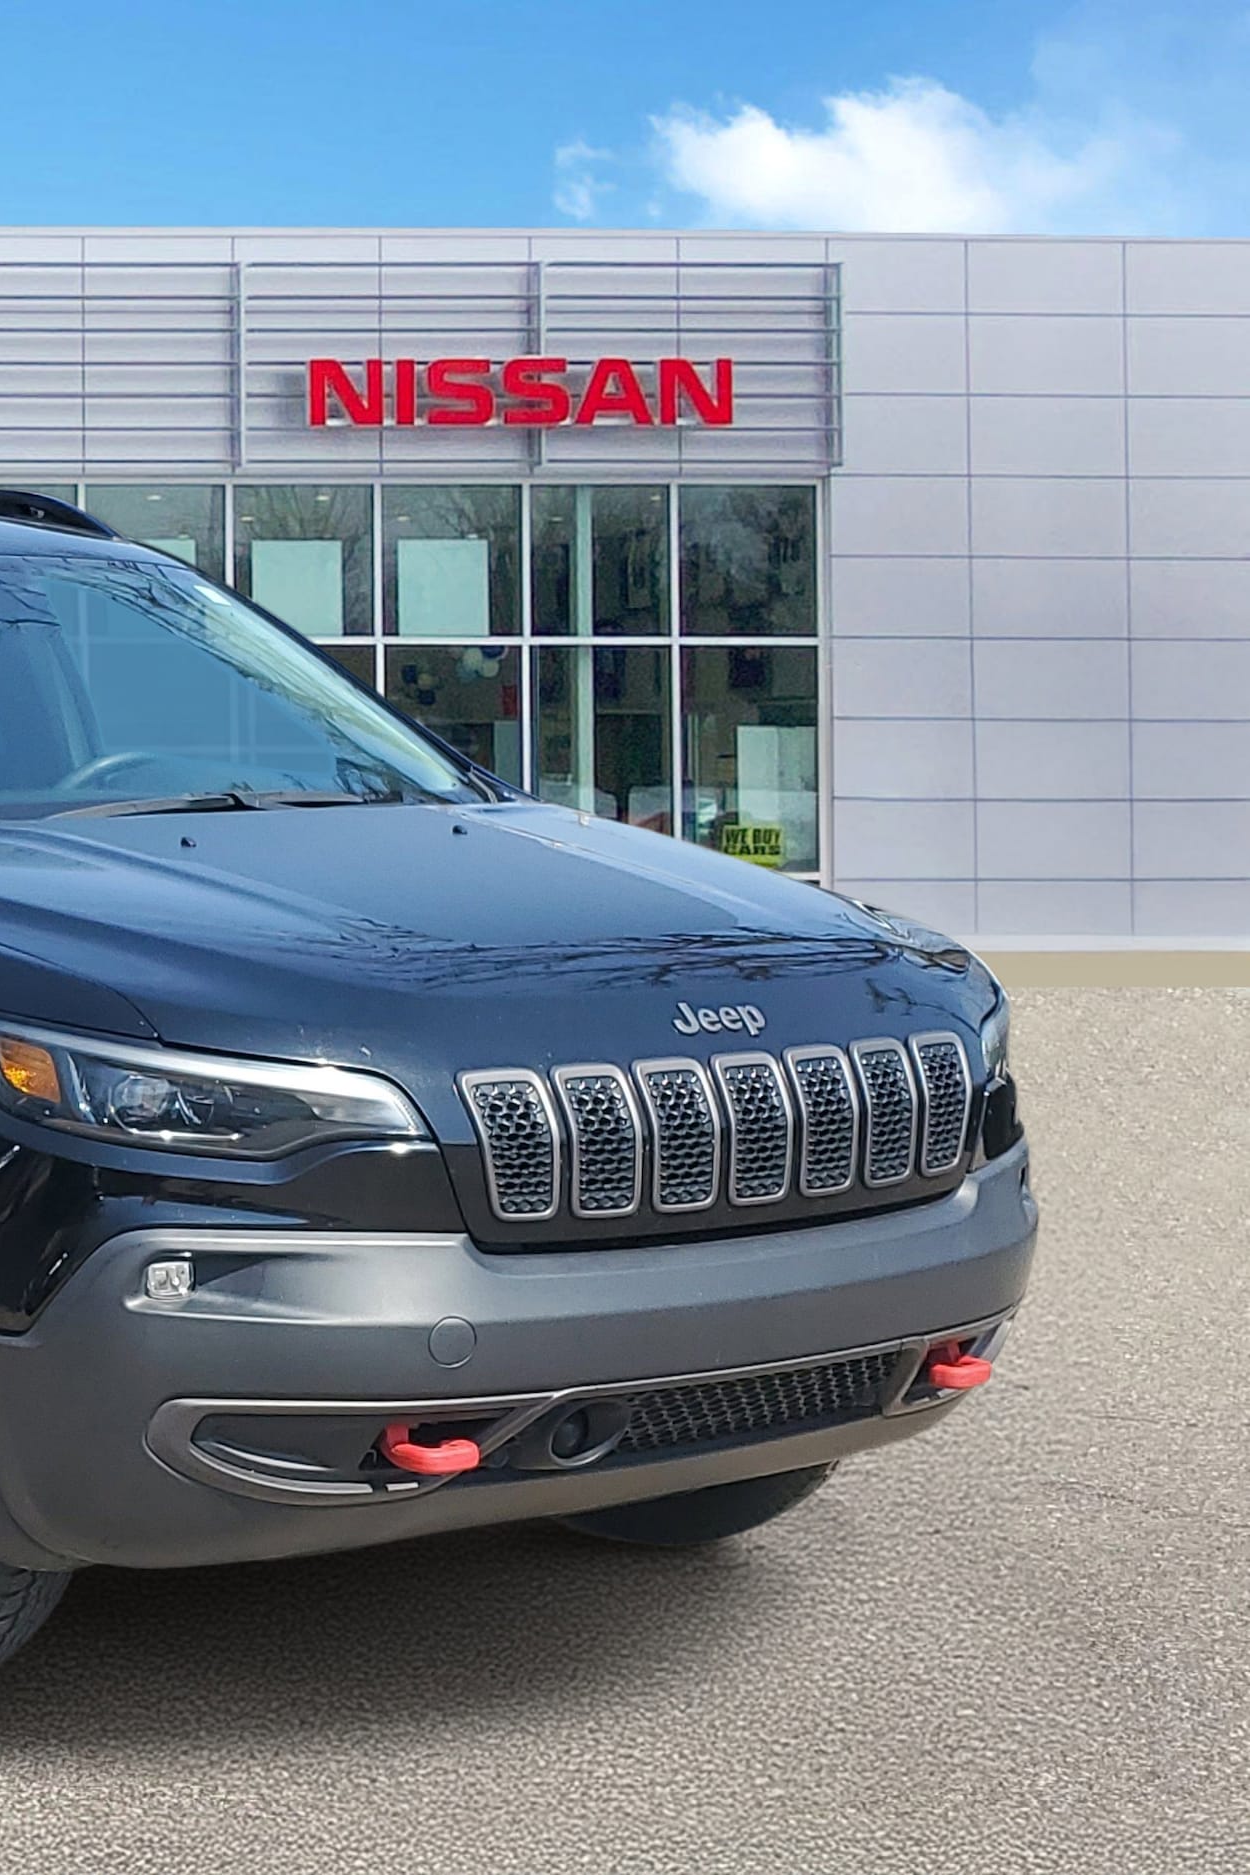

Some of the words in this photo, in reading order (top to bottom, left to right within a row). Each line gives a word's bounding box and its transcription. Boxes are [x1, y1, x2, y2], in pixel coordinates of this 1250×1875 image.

[308, 357, 734, 426] NISSAN
[723, 844, 781, 856] CARS
[724, 828, 749, 845] WE
[752, 828, 781, 845] BUY
[672, 1000, 767, 1037] Jeep
